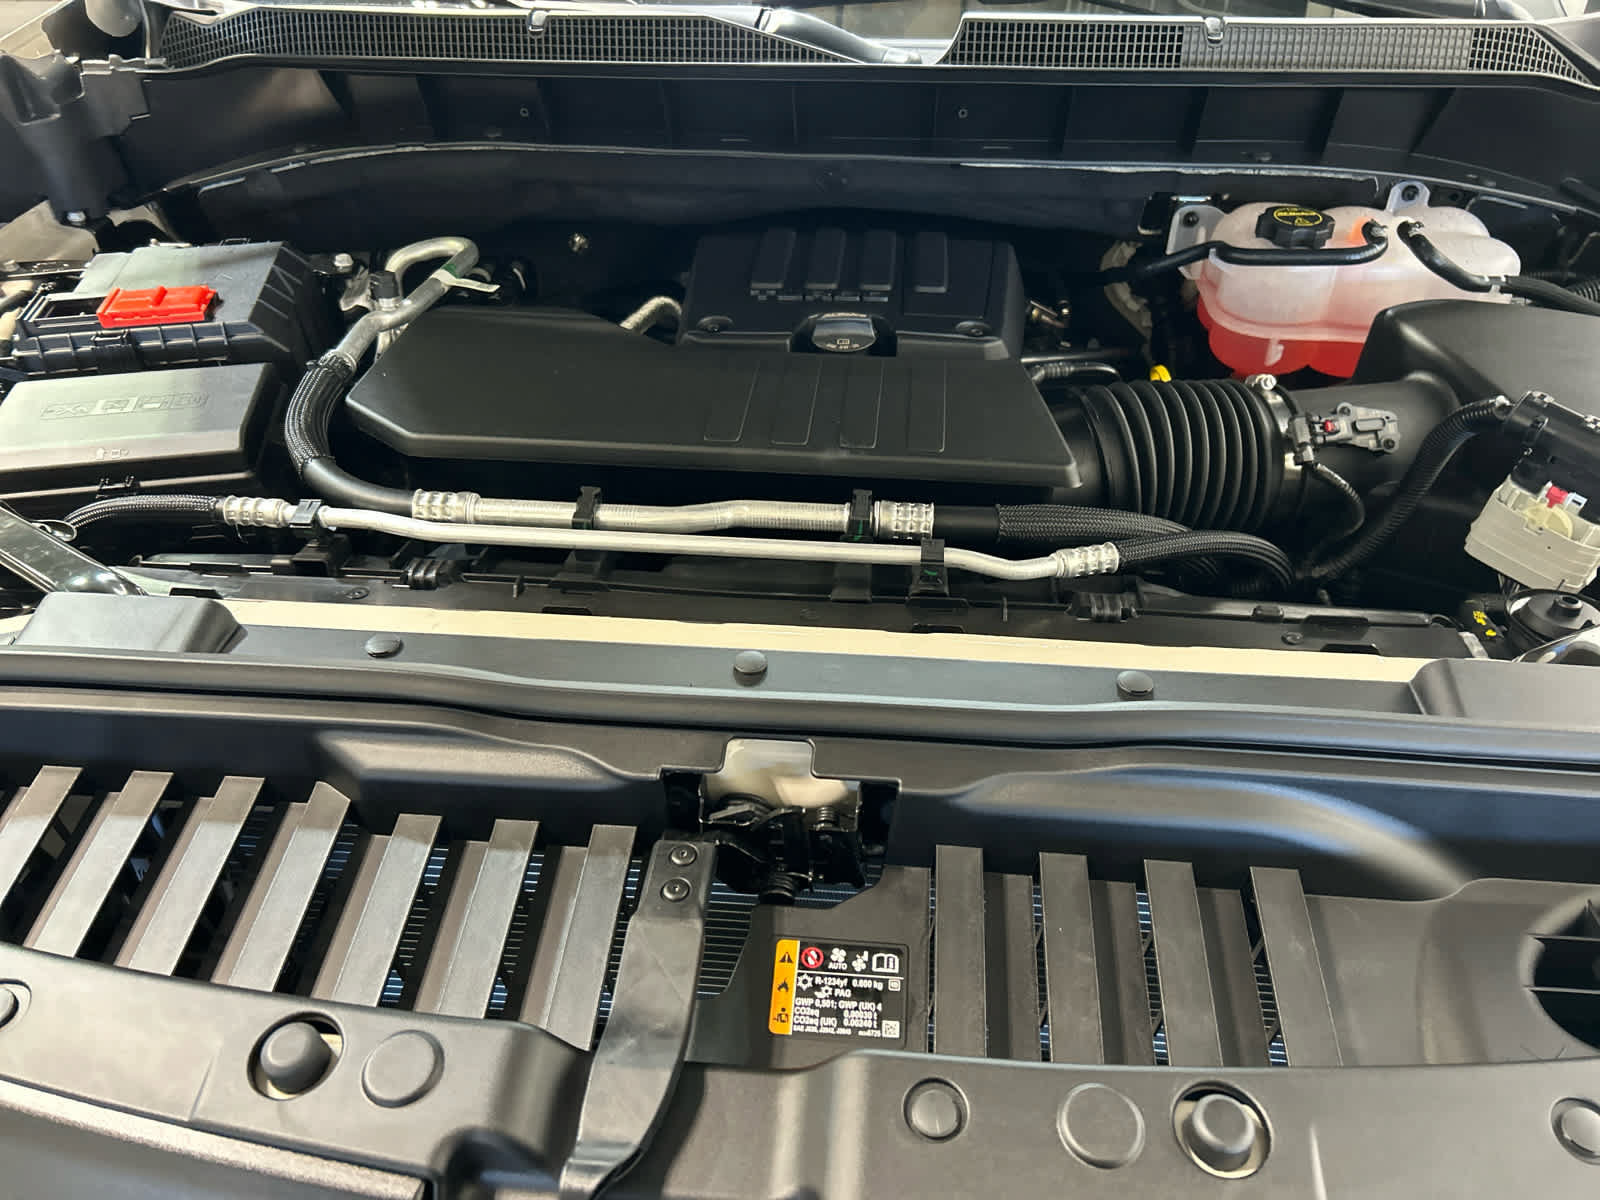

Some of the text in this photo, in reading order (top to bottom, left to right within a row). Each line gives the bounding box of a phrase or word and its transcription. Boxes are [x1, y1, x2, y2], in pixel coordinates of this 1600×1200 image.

[828, 962, 847, 970] AUTO
[815, 976, 848, 988] R-1234yf
[834, 989, 852, 998] PAG
[795, 997, 814, 1006] GWP
[838, 1000, 857, 1009] GWP
[794, 1007, 820, 1017] CO2eq
